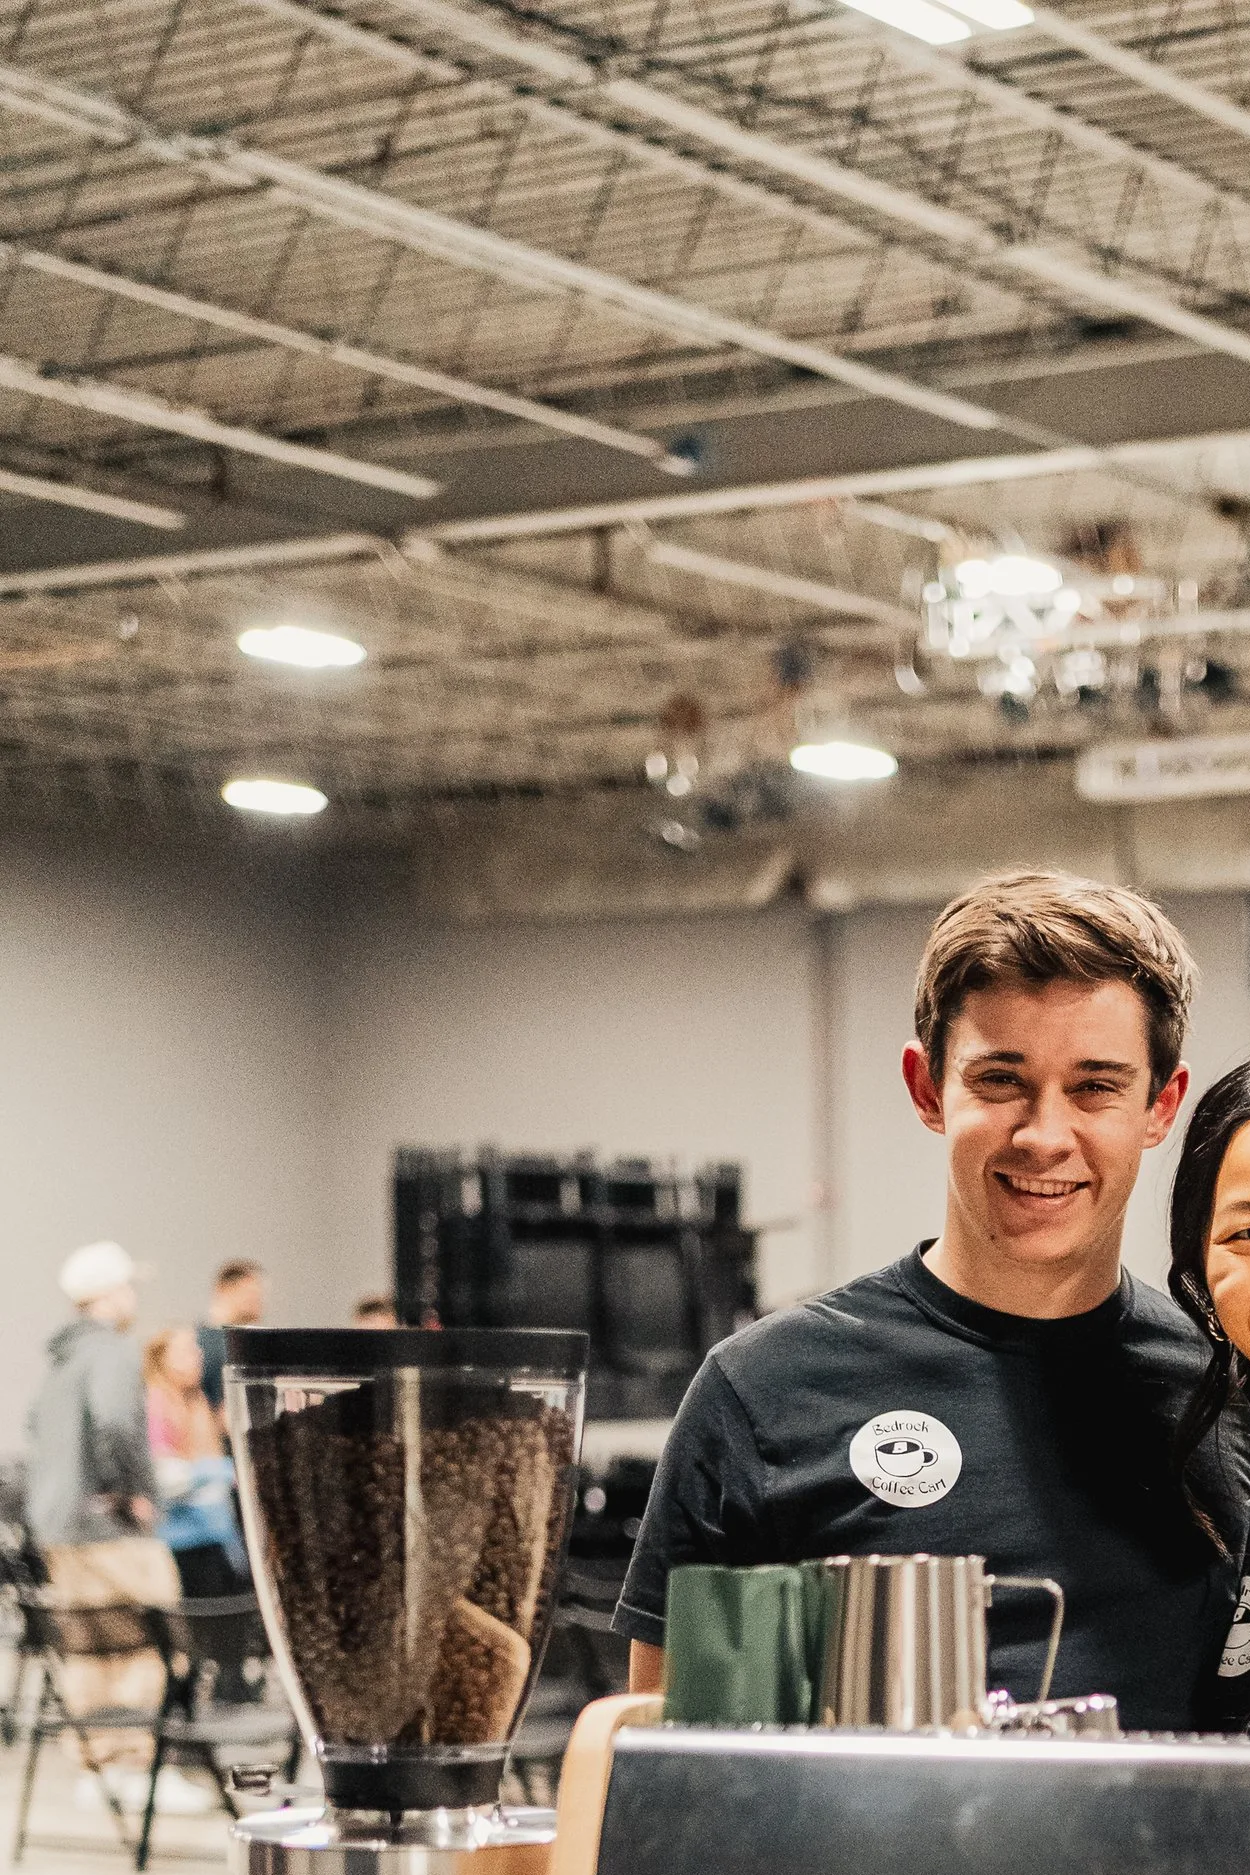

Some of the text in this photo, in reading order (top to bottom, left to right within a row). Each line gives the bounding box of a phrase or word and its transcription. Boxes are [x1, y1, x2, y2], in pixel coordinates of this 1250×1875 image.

[872, 1420, 929, 1436] Bedrock
[871, 1476, 947, 1495] Coffee Cart
